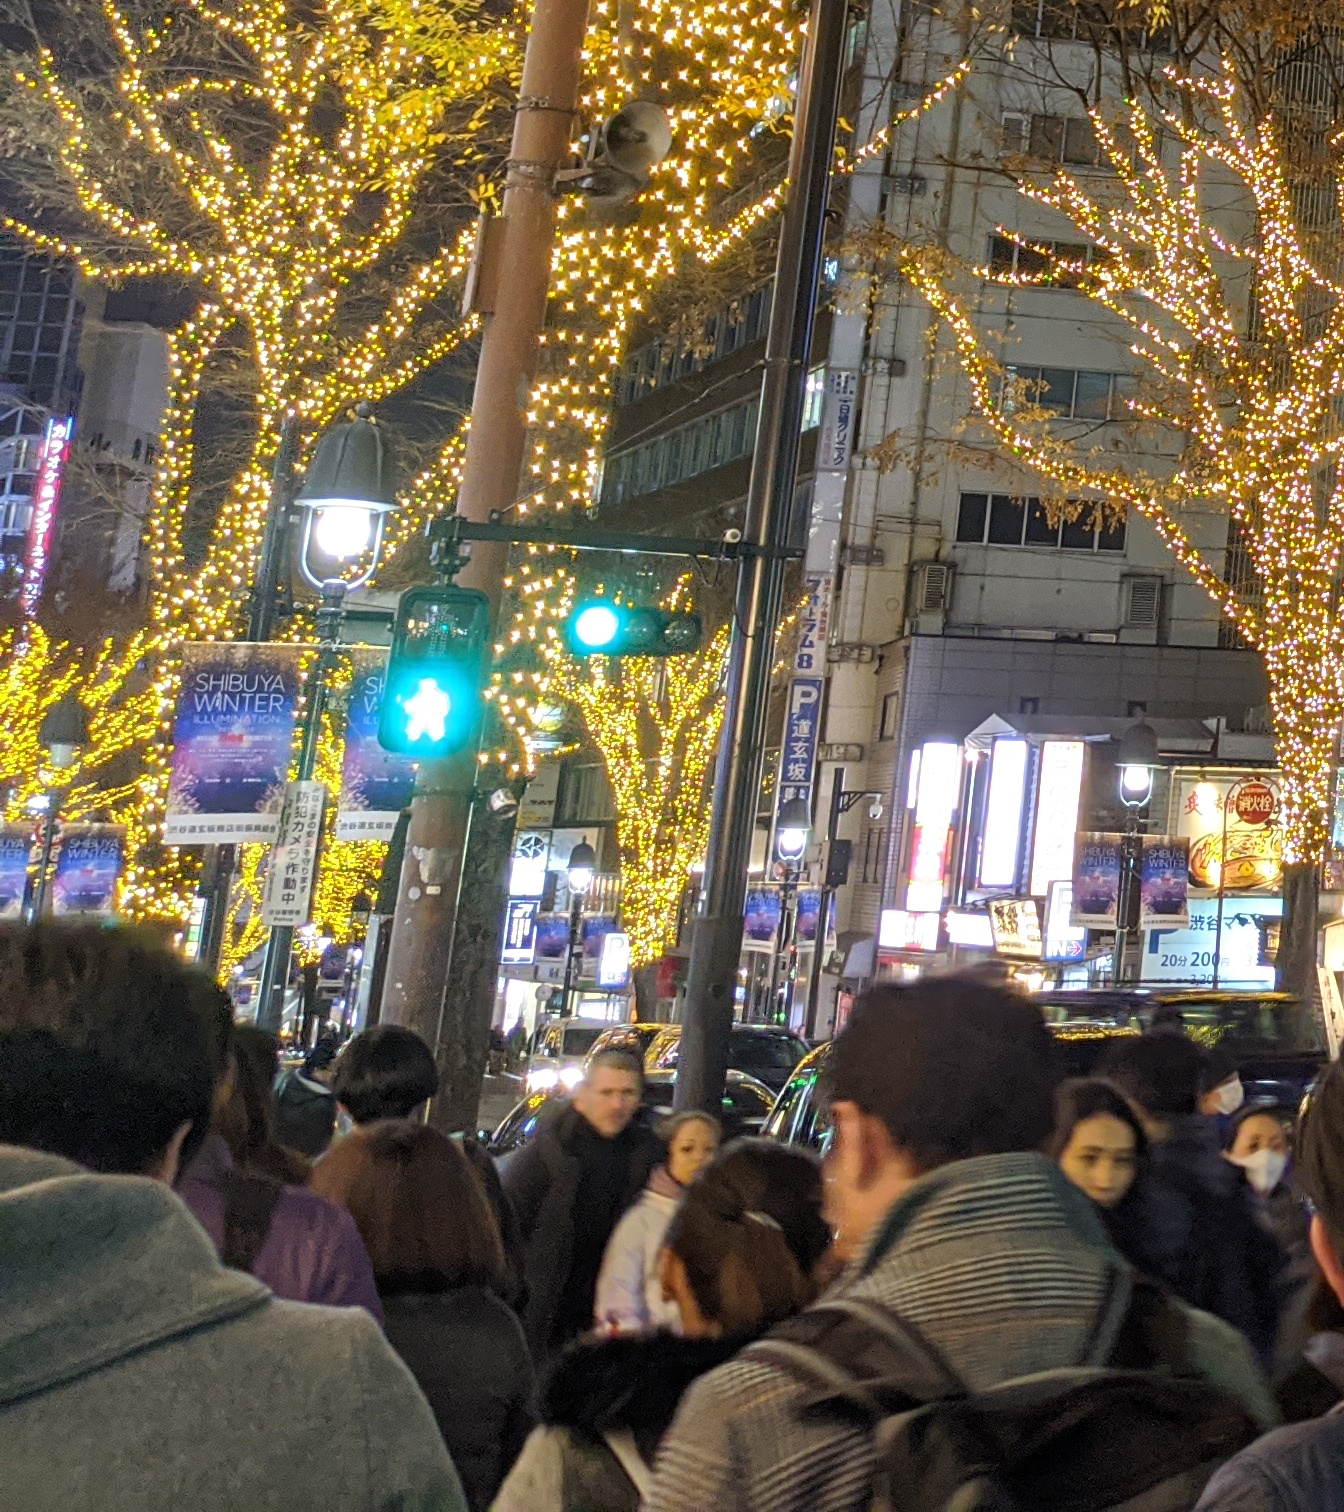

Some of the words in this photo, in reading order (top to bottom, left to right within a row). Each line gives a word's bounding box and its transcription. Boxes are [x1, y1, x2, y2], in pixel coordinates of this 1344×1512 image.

[195, 672, 285, 692] SHIBUYA
[193, 693, 285, 713] WINTER
[787, 720, 812, 781] 道玄坂
[1239, 794, 1272, 812] 消火栓
[282, 791, 309, 905] 防犯カメラ作動中
[1080, 847, 1116, 857] SHIBUYA
[1150, 847, 1185, 858] SHIBUYA
[1079, 857, 1116, 867] WINTER
[1150, 858, 1185, 869] WINTER
[1189, 914, 1238, 932] 渋谷マ
[1047, 941, 1067, 957] IN
[1160, 954, 1187, 967] 20分
